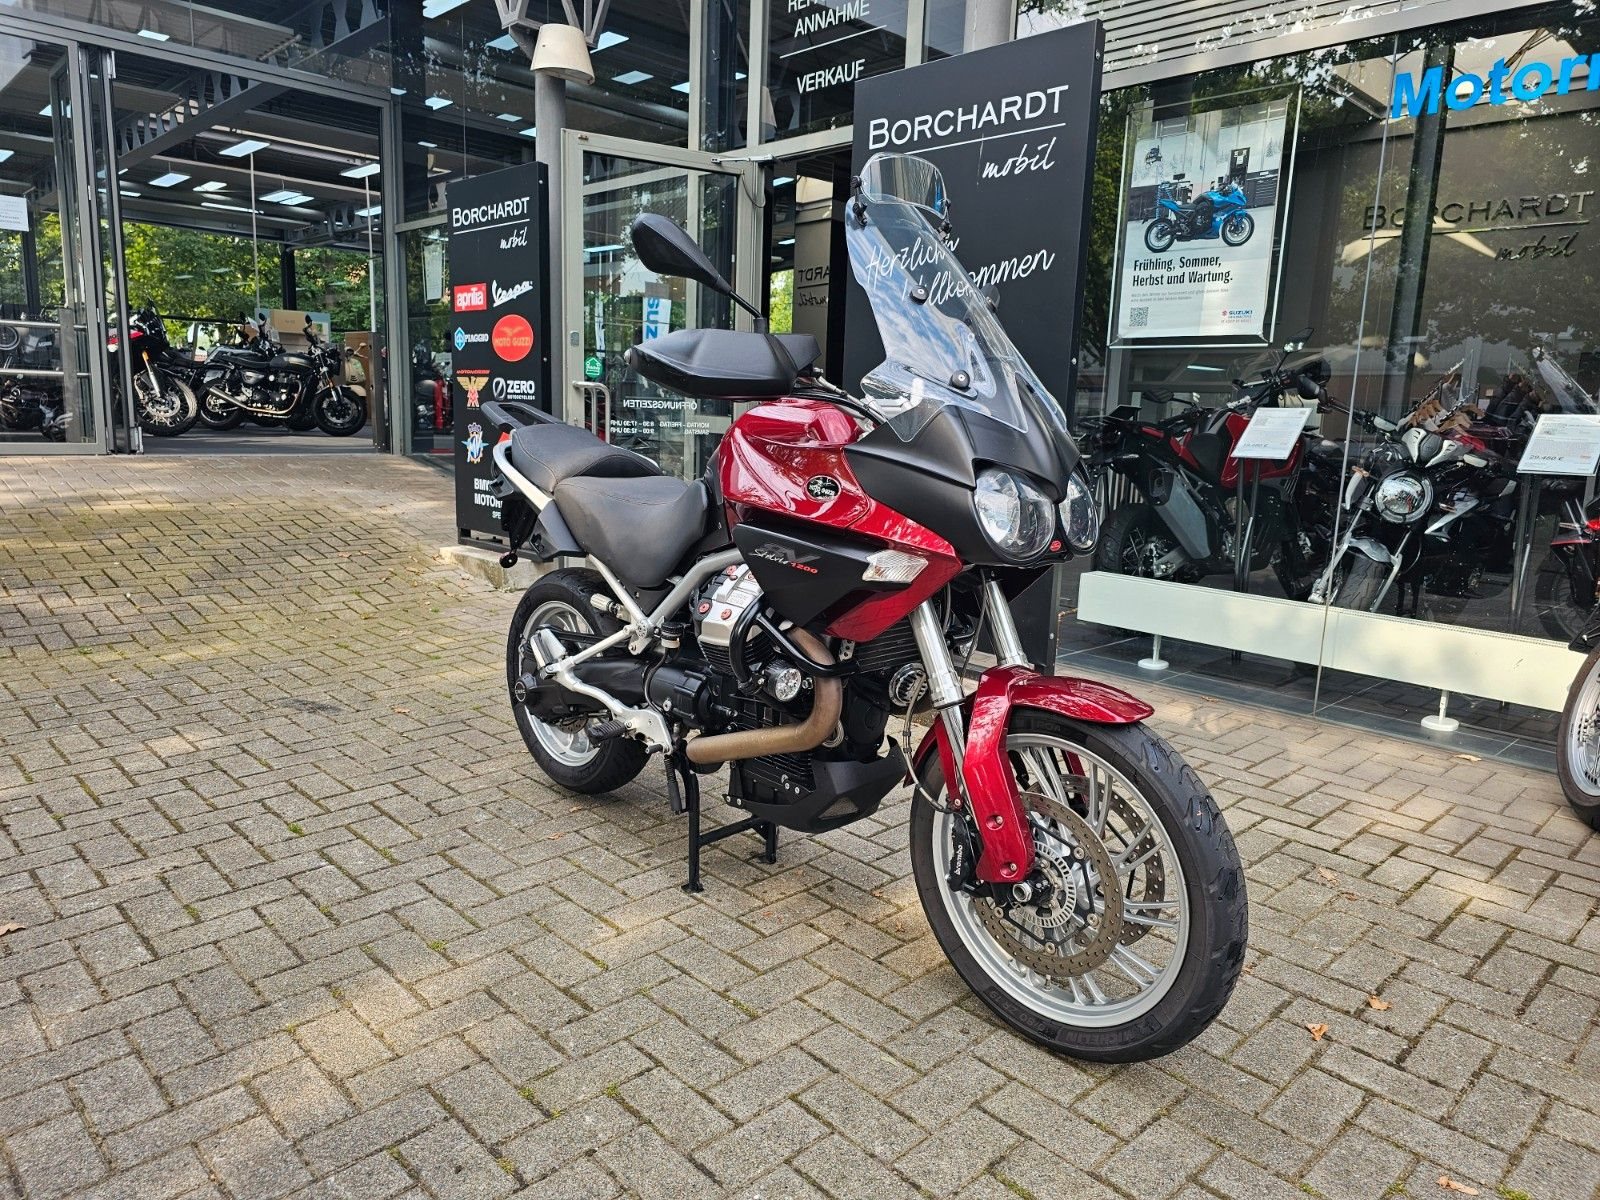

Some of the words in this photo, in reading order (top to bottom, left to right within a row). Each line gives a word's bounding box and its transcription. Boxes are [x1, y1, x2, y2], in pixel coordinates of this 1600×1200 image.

[794, 0, 870, 38] ANNAHME
[796, 59, 866, 94] VERKAUF
[982, 136, 1057, 179] mobil
[1363, 191, 1595, 230] BOCHARDT
[500, 226, 528, 249] mobil
[1132, 274, 1164, 287] Herbst
[1166, 272, 1185, 285] und
[1188, 270, 1233, 284] Wartung.
[1133, 258, 1176, 272] Frühling,
[1179, 256, 1221, 269] Sommer,
[645, 295, 660, 340] SUZ
[507, 380, 535, 394] ZERO
[790, 562, 818, 574] 1200
[953, 844, 963, 876] brembo
